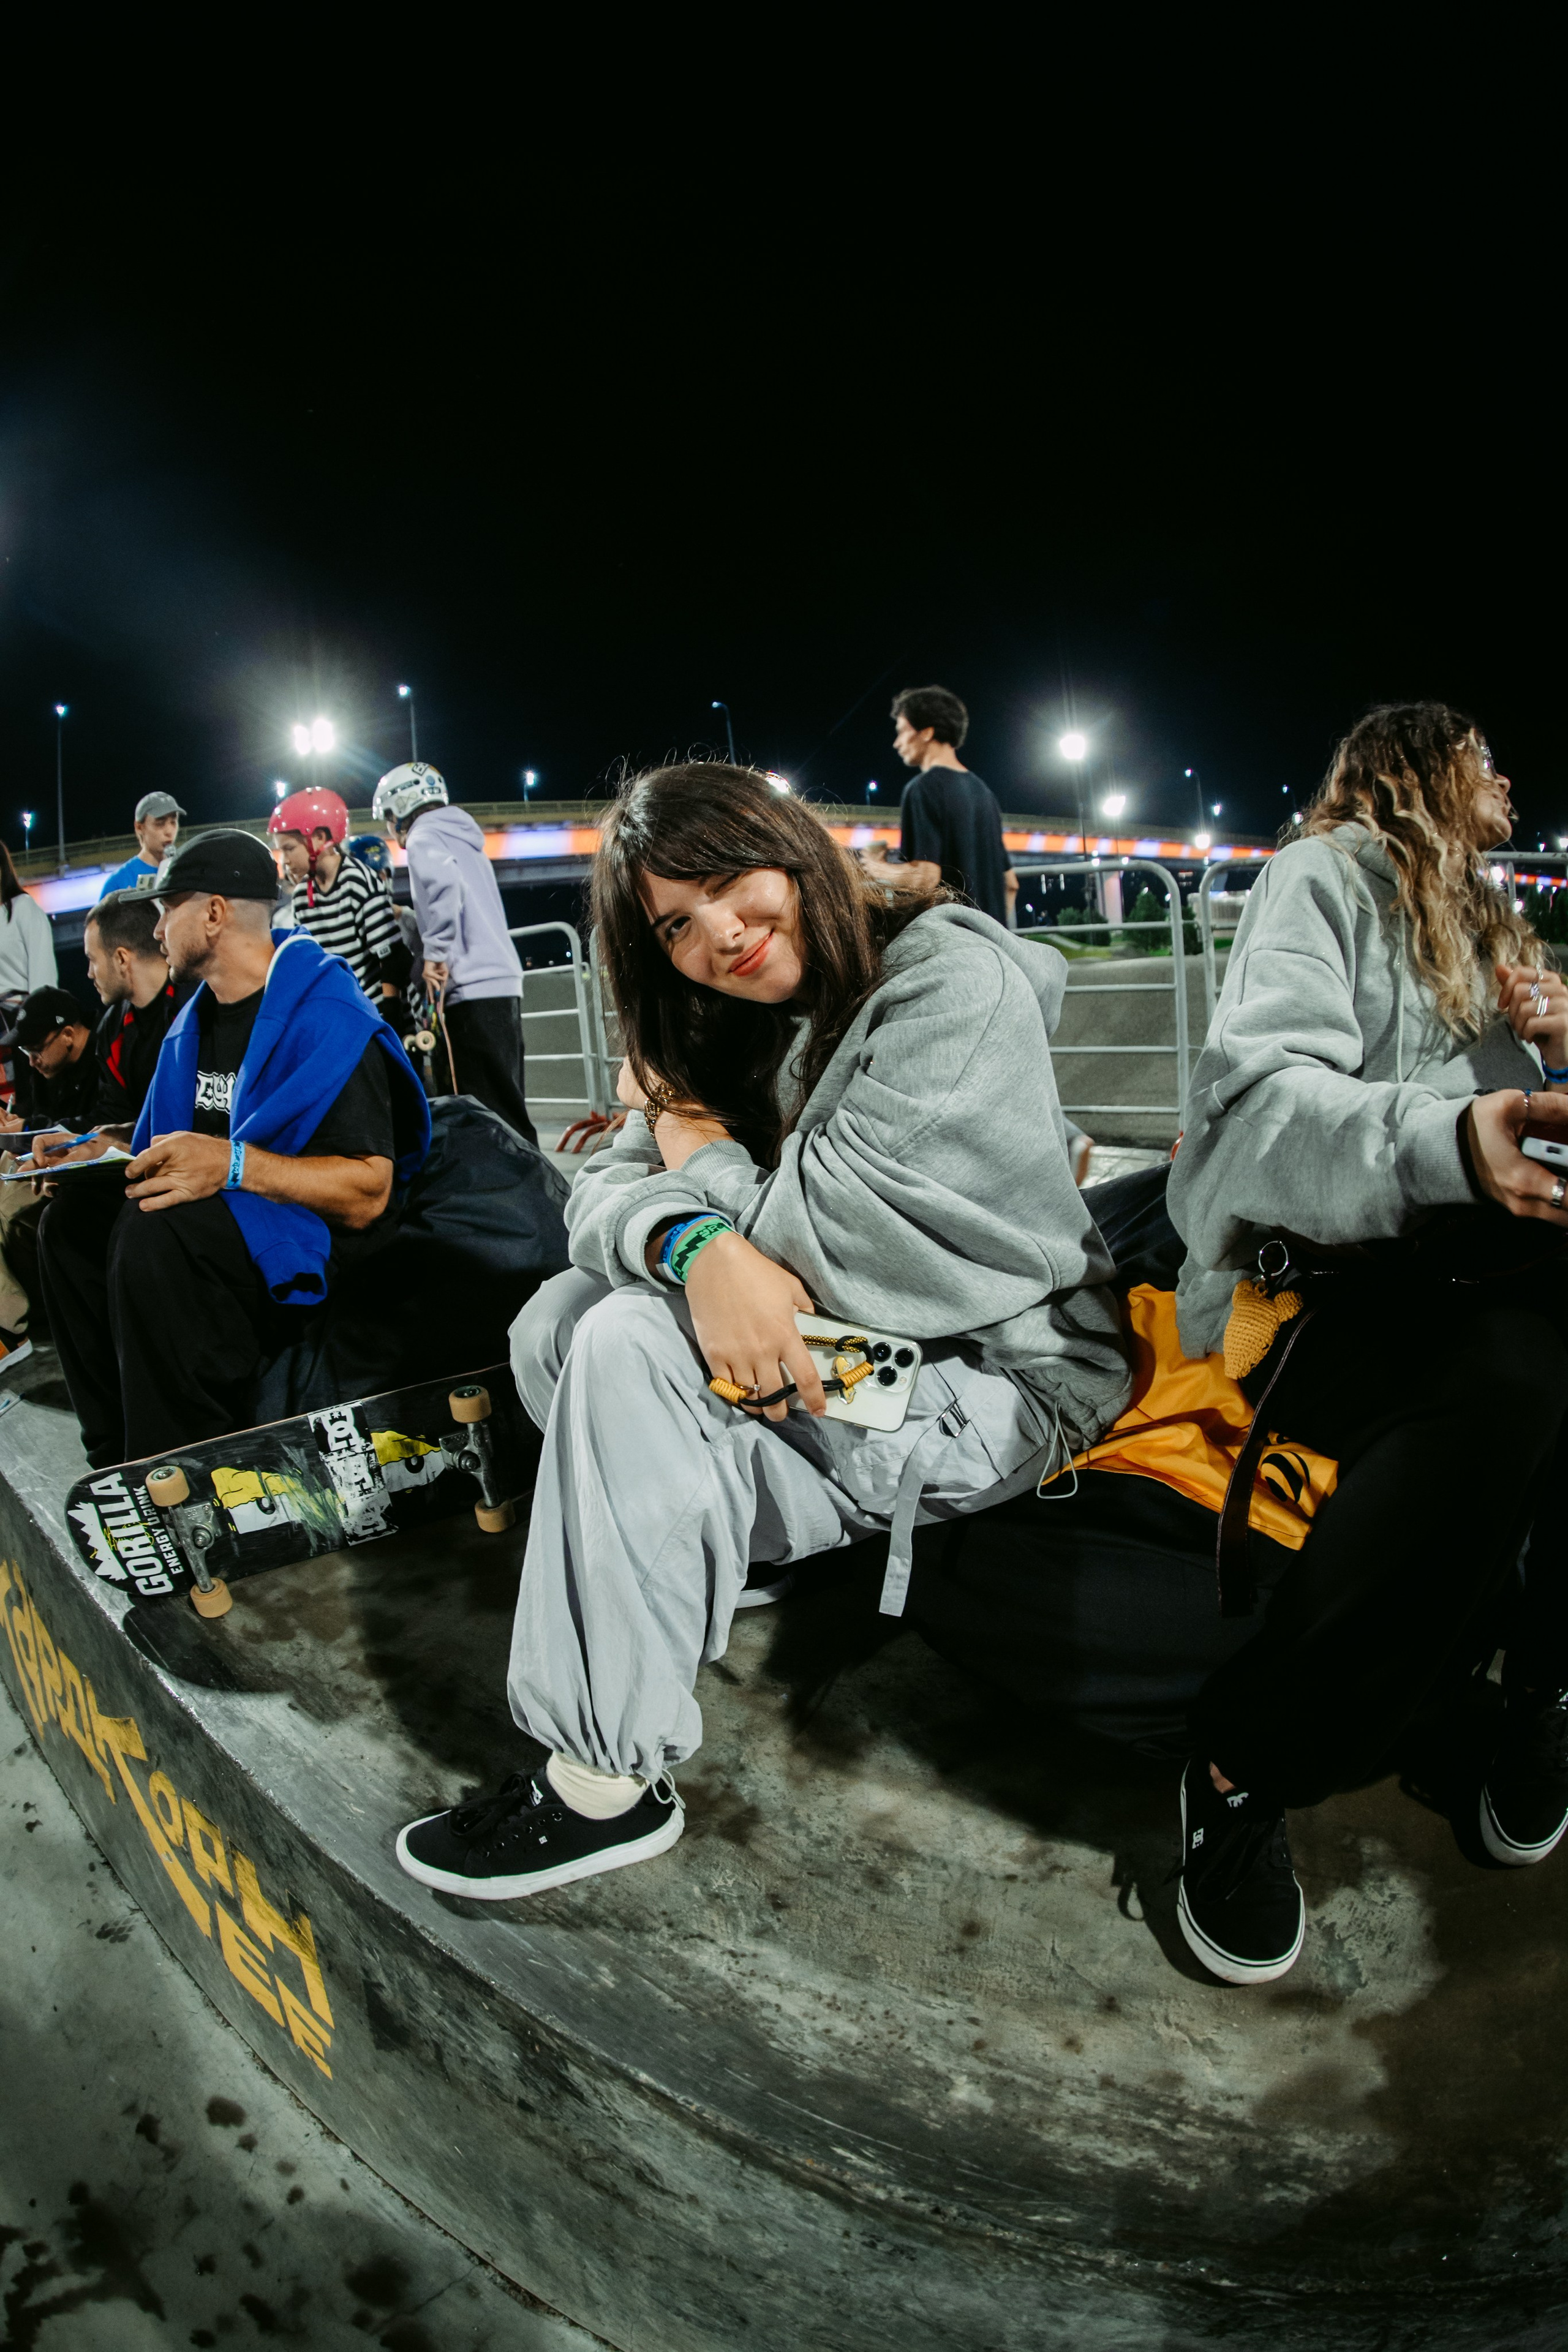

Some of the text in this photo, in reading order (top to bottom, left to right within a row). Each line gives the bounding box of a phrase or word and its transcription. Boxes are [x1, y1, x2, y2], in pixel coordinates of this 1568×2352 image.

[89, 1472, 174, 1596] GORILLA
[133, 1485, 184, 1574] ENERGY DRINK
